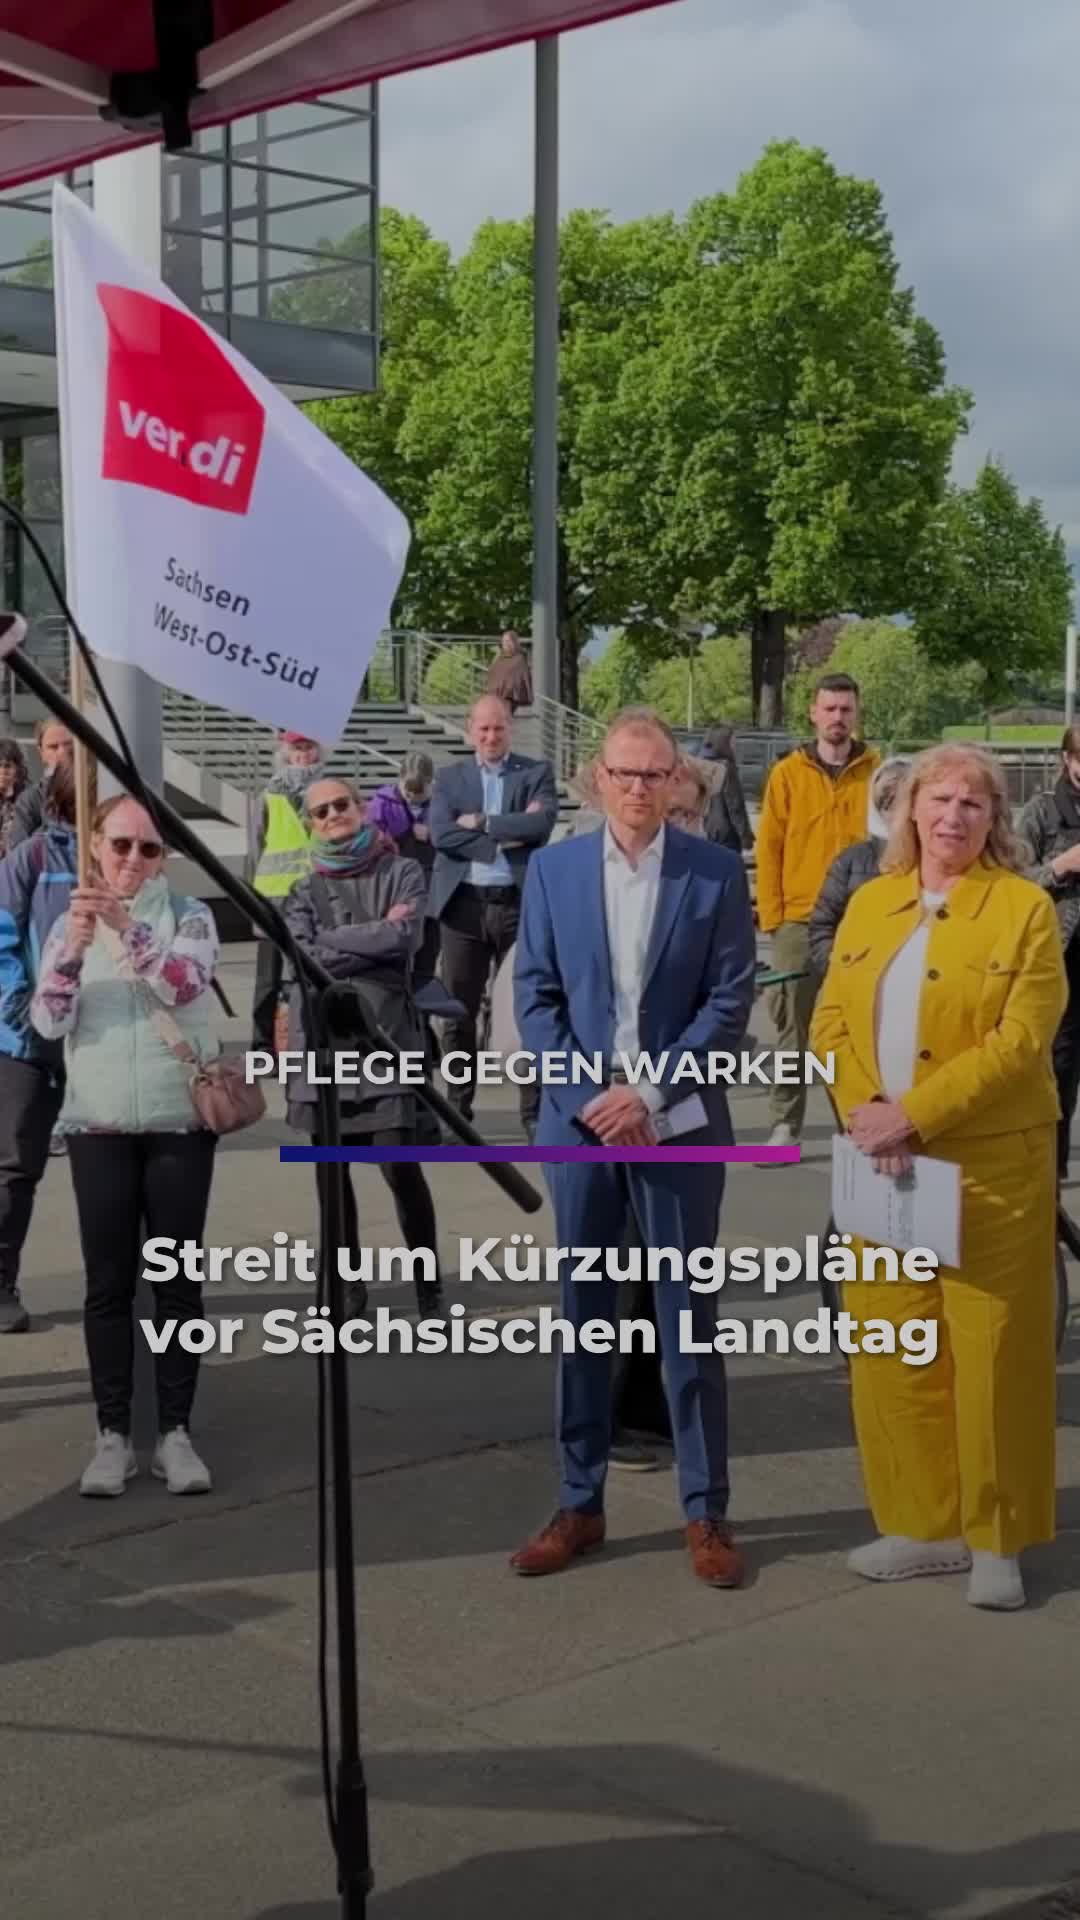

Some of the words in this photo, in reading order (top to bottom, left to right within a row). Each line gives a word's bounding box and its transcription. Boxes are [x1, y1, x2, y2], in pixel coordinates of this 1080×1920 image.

[119, 400, 246, 486] ver.di
[164, 556, 251, 617] Sachsen
[154, 601, 320, 691] West-Ost-Süd
